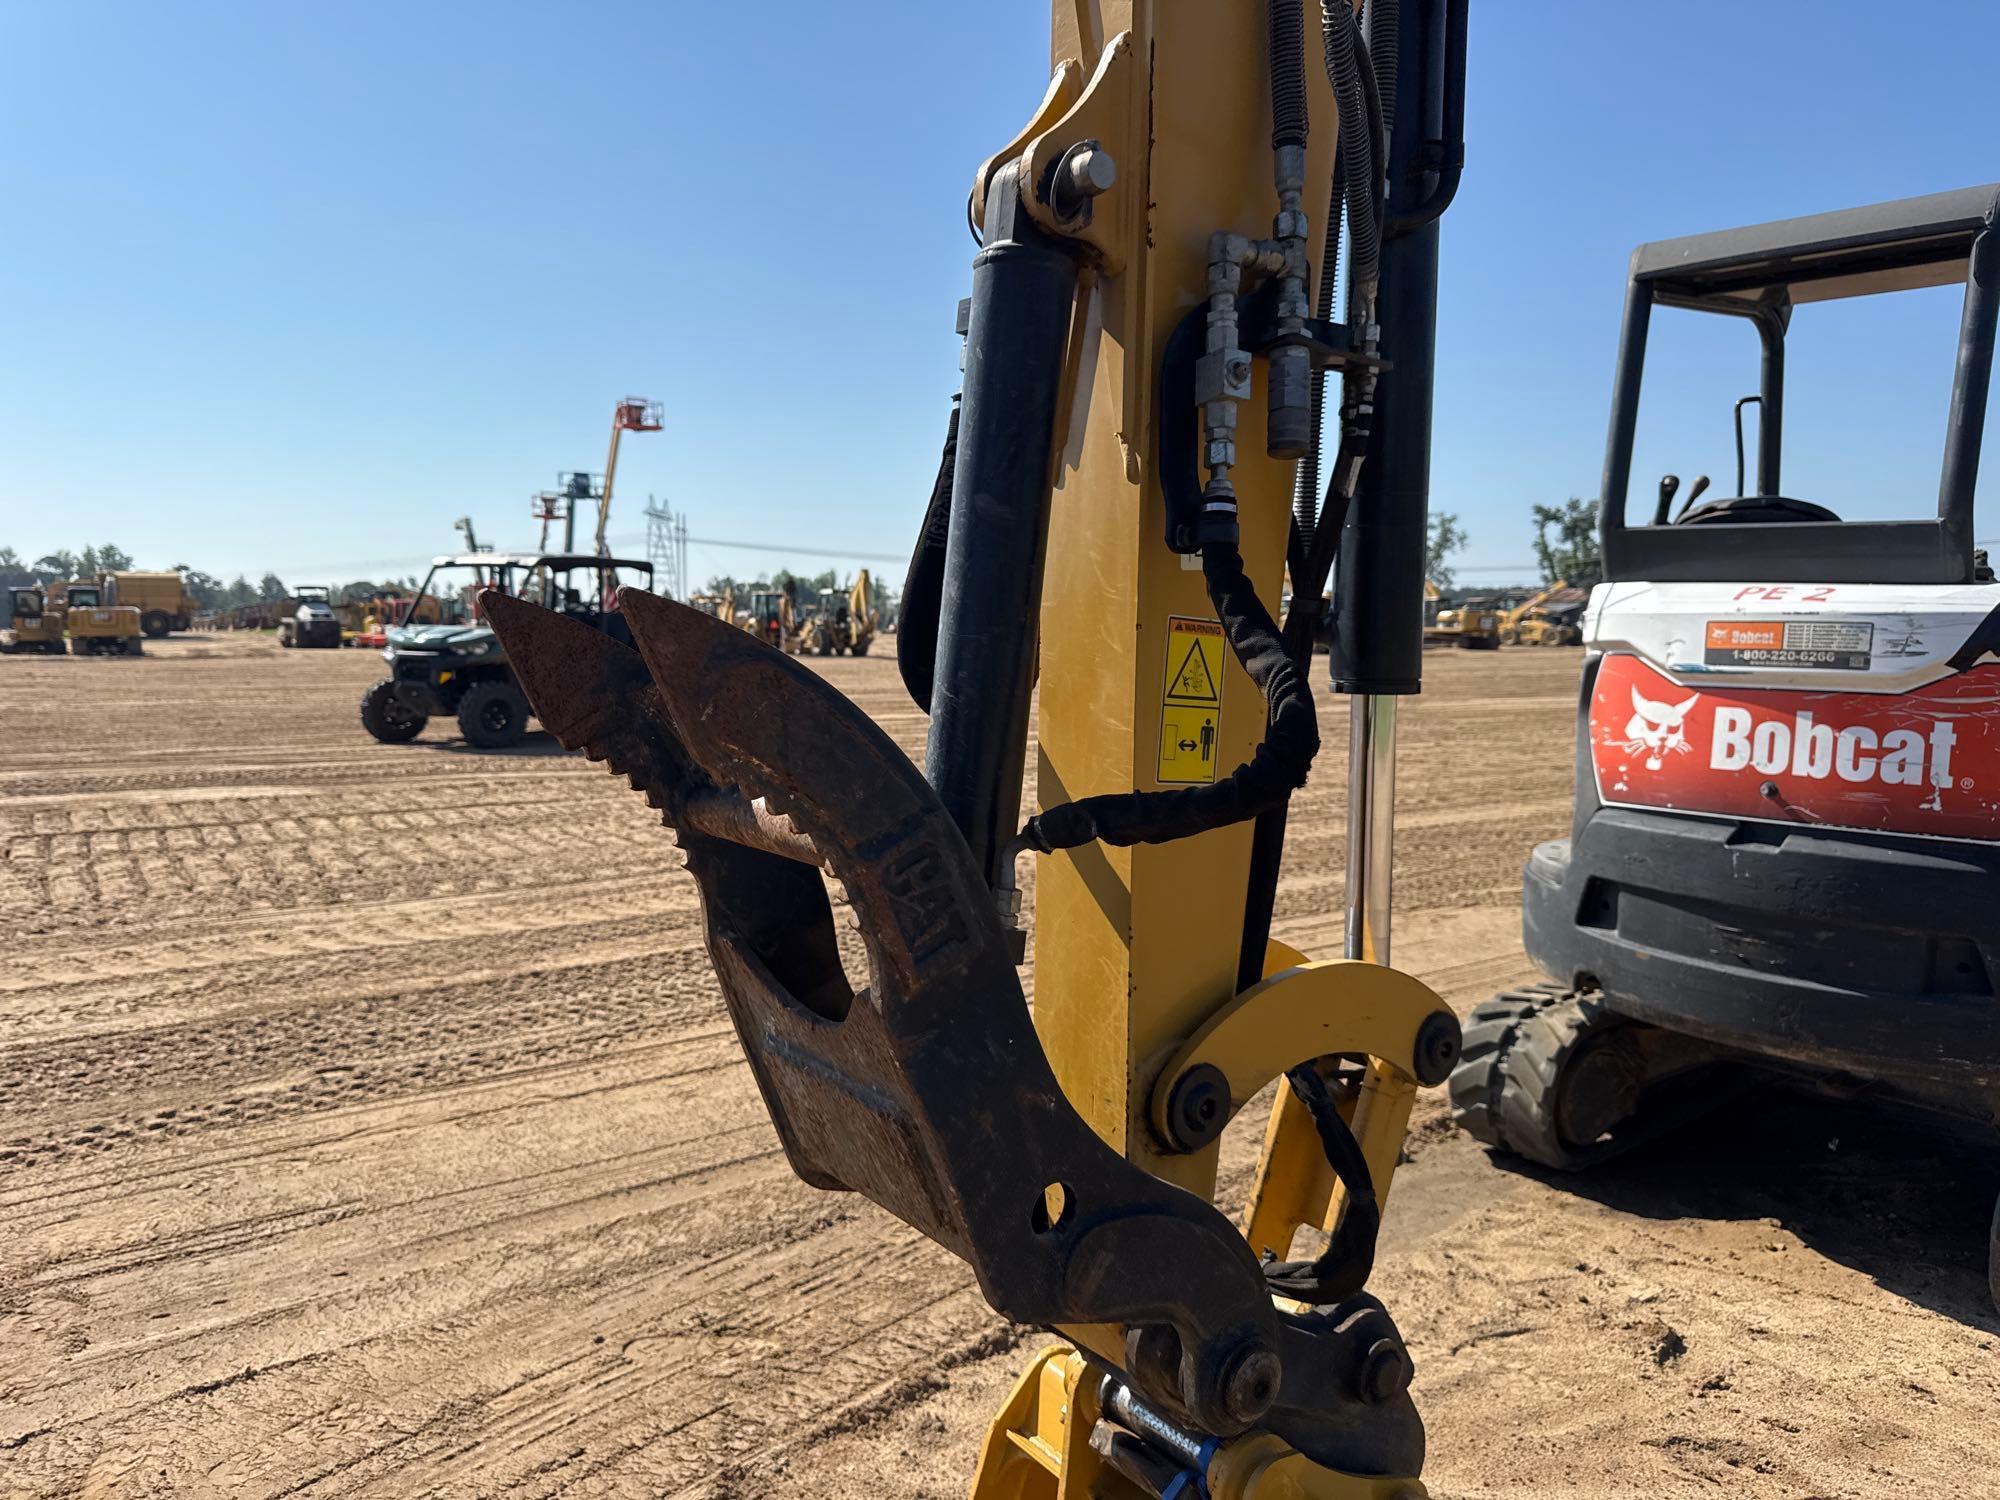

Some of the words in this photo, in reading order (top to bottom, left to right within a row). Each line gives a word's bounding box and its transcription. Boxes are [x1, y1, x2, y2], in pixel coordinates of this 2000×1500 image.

[1733, 586, 1794, 601] PE
[1802, 587, 1836, 603] 2
[1184, 622, 1221, 636] WARNING
[1731, 629, 1775, 645] Bobcat
[1709, 706, 1957, 789] Bobcat
[882, 840, 972, 964] CAT
